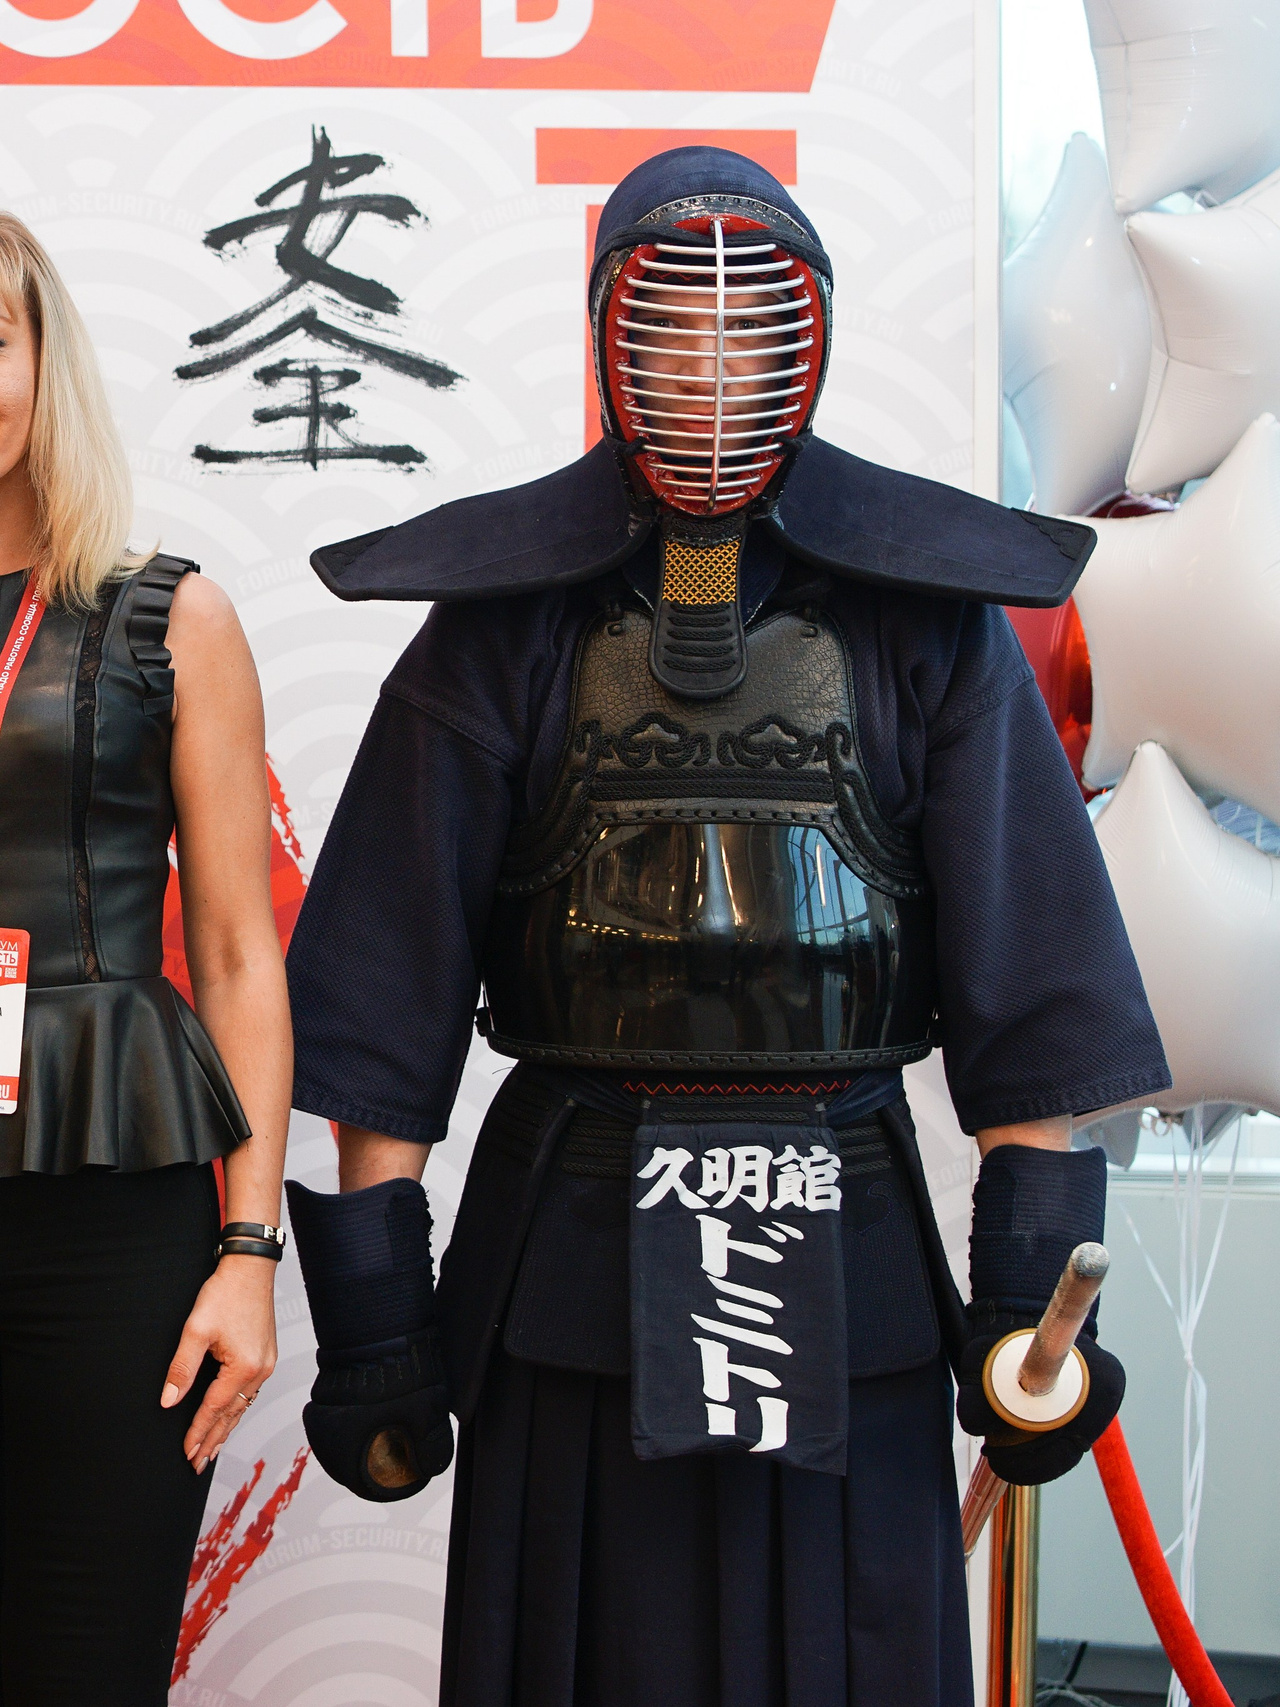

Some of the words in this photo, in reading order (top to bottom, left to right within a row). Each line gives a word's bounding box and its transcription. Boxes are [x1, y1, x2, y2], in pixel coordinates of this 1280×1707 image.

[4, 636, 25, 670] РАБОТАТЬ
[635, 1144, 843, 1213] 久明館
[690, 1213, 805, 1454] ドミトリ
